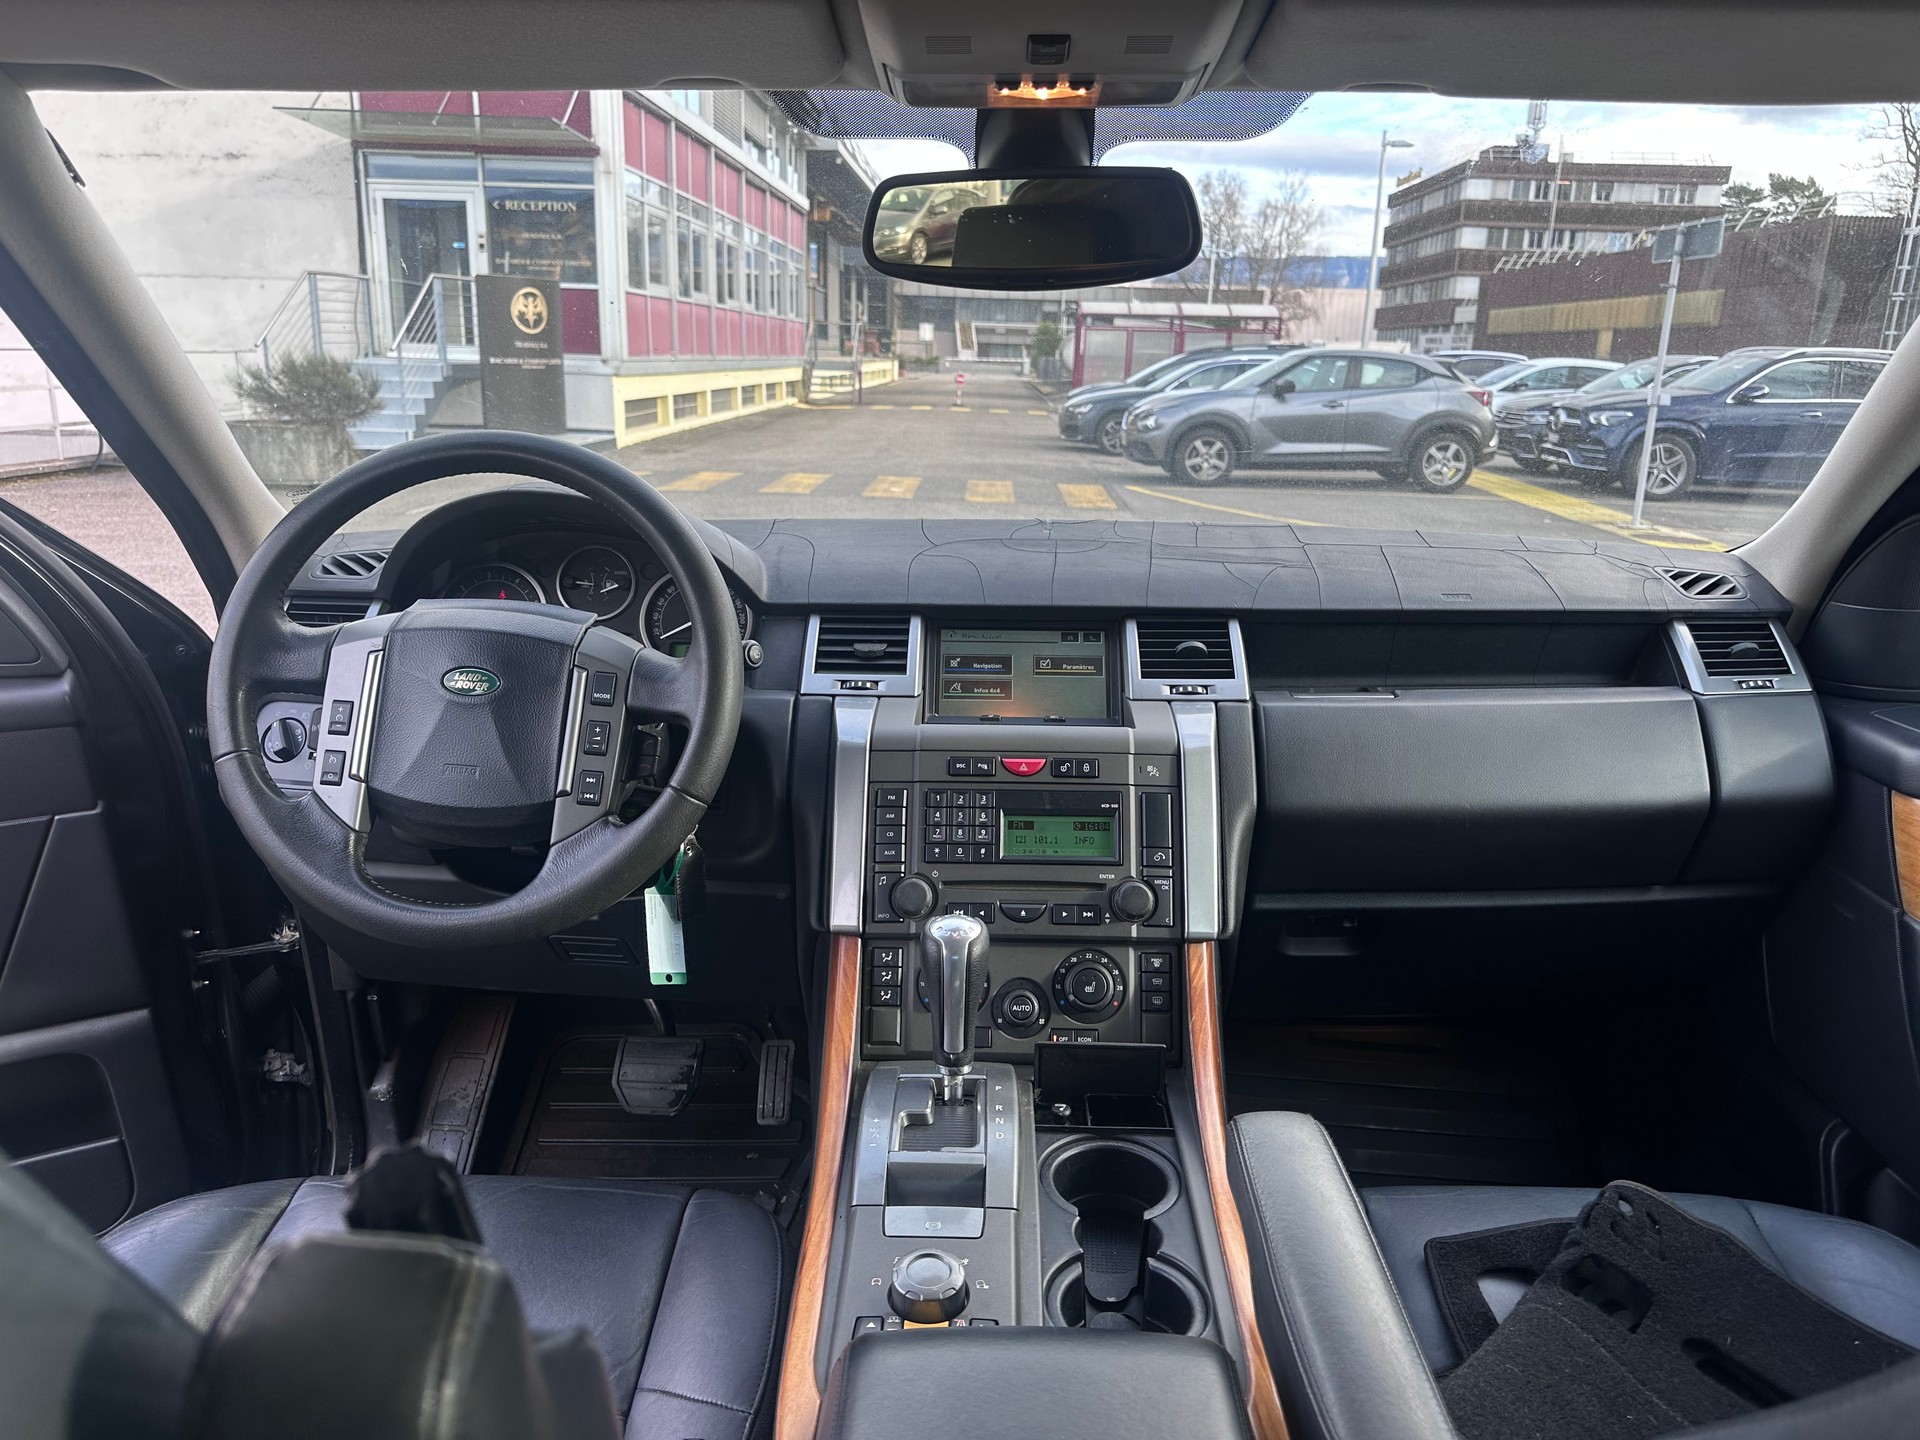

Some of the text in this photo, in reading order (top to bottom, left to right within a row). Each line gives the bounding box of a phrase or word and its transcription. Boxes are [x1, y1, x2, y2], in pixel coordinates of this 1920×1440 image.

[505, 199, 577, 212] RECEPTION
[972, 662, 1003, 670] Navigation
[453, 672, 482, 682] LAND
[455, 680, 489, 691] ROVER
[593, 692, 611, 700] MODE
[1084, 822, 1109, 831] 16:04
[1034, 836, 1059, 845] 101.1
[1074, 836, 1095, 845] INFO
